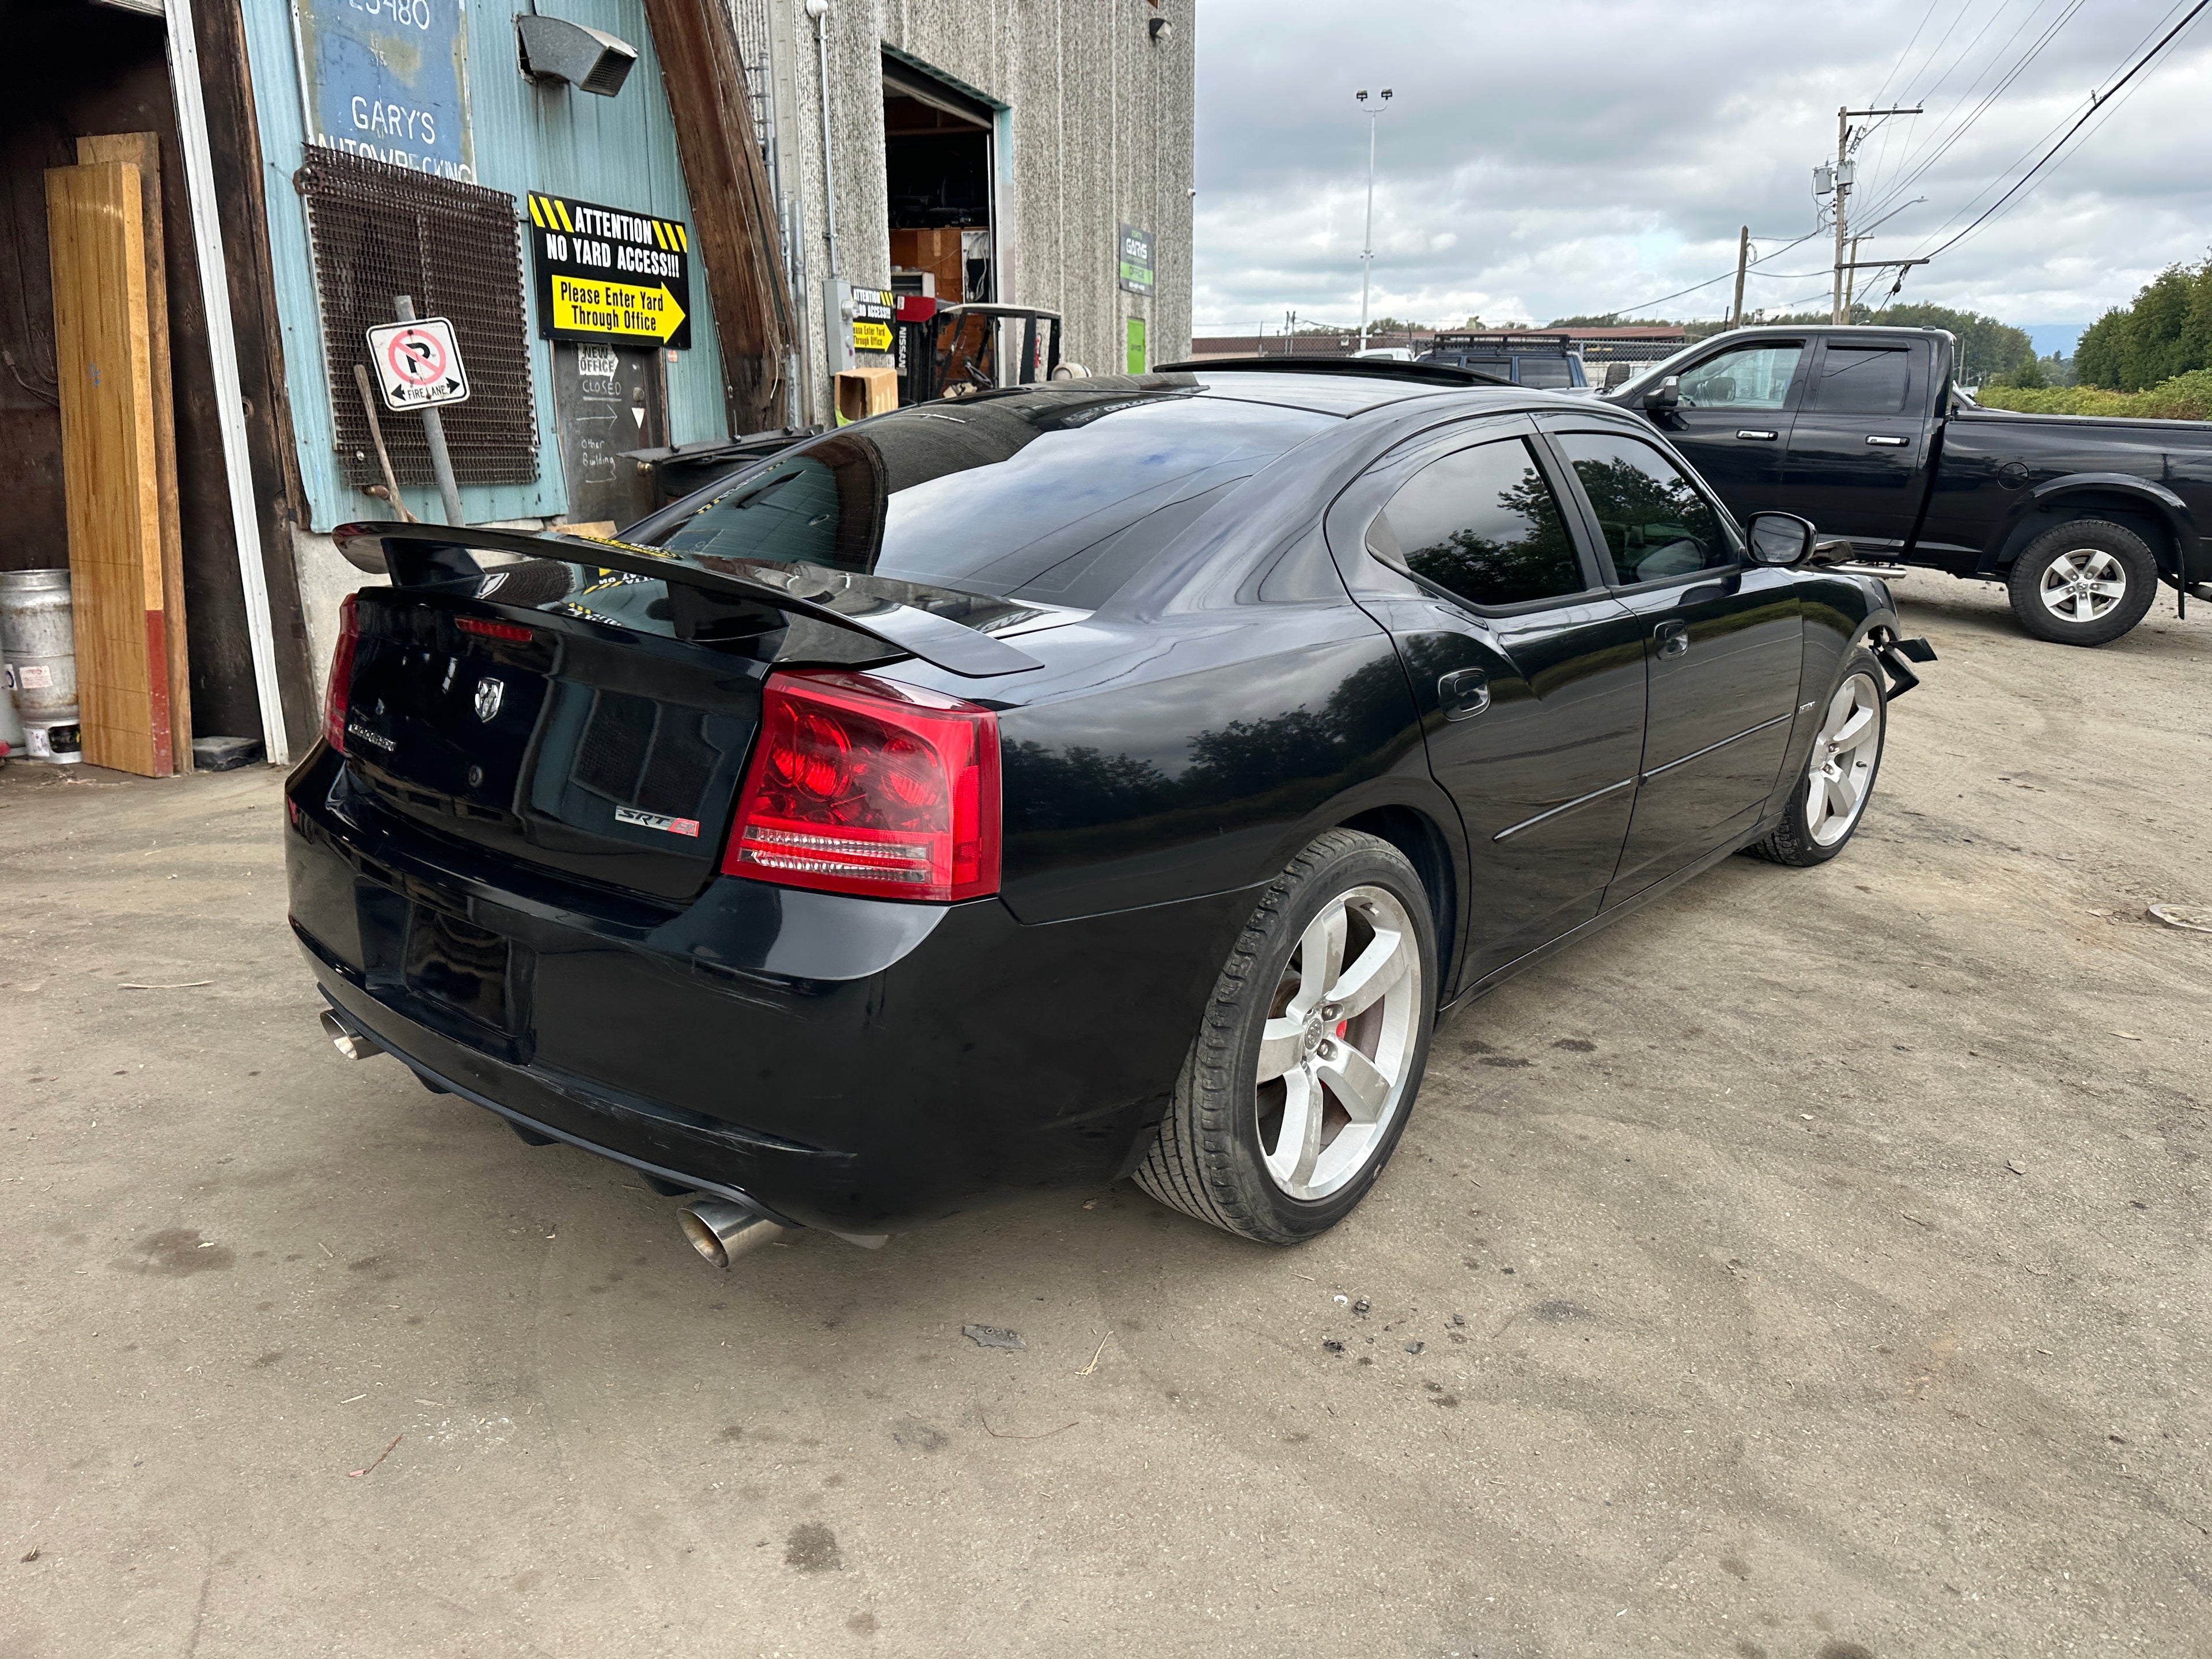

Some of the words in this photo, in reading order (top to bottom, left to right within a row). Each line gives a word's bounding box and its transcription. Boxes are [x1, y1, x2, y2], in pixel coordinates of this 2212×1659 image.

[351, 96, 435, 144] GARY'S
[575, 206, 653, 245] ATTENTION
[546, 233, 568, 262] NO
[572, 237, 611, 268] YARD
[617, 245, 680, 278] ACCESS!!!
[560, 281, 600, 305] Please
[605, 287, 635, 309] Enter
[640, 291, 664, 312] Yard
[853, 288, 881, 304] ATTENTION
[571, 305, 619, 331] Through
[624, 310, 657, 331] Office
[864, 325, 875, 335] Enter
[583, 344, 608, 358] NEW
[899, 327, 907, 368] NISSAN
[580, 358, 615, 373] OFFICE
[407, 388, 425, 400] FIRE
[582, 380, 622, 395] CLOSED
[581, 438, 605, 449] Other
